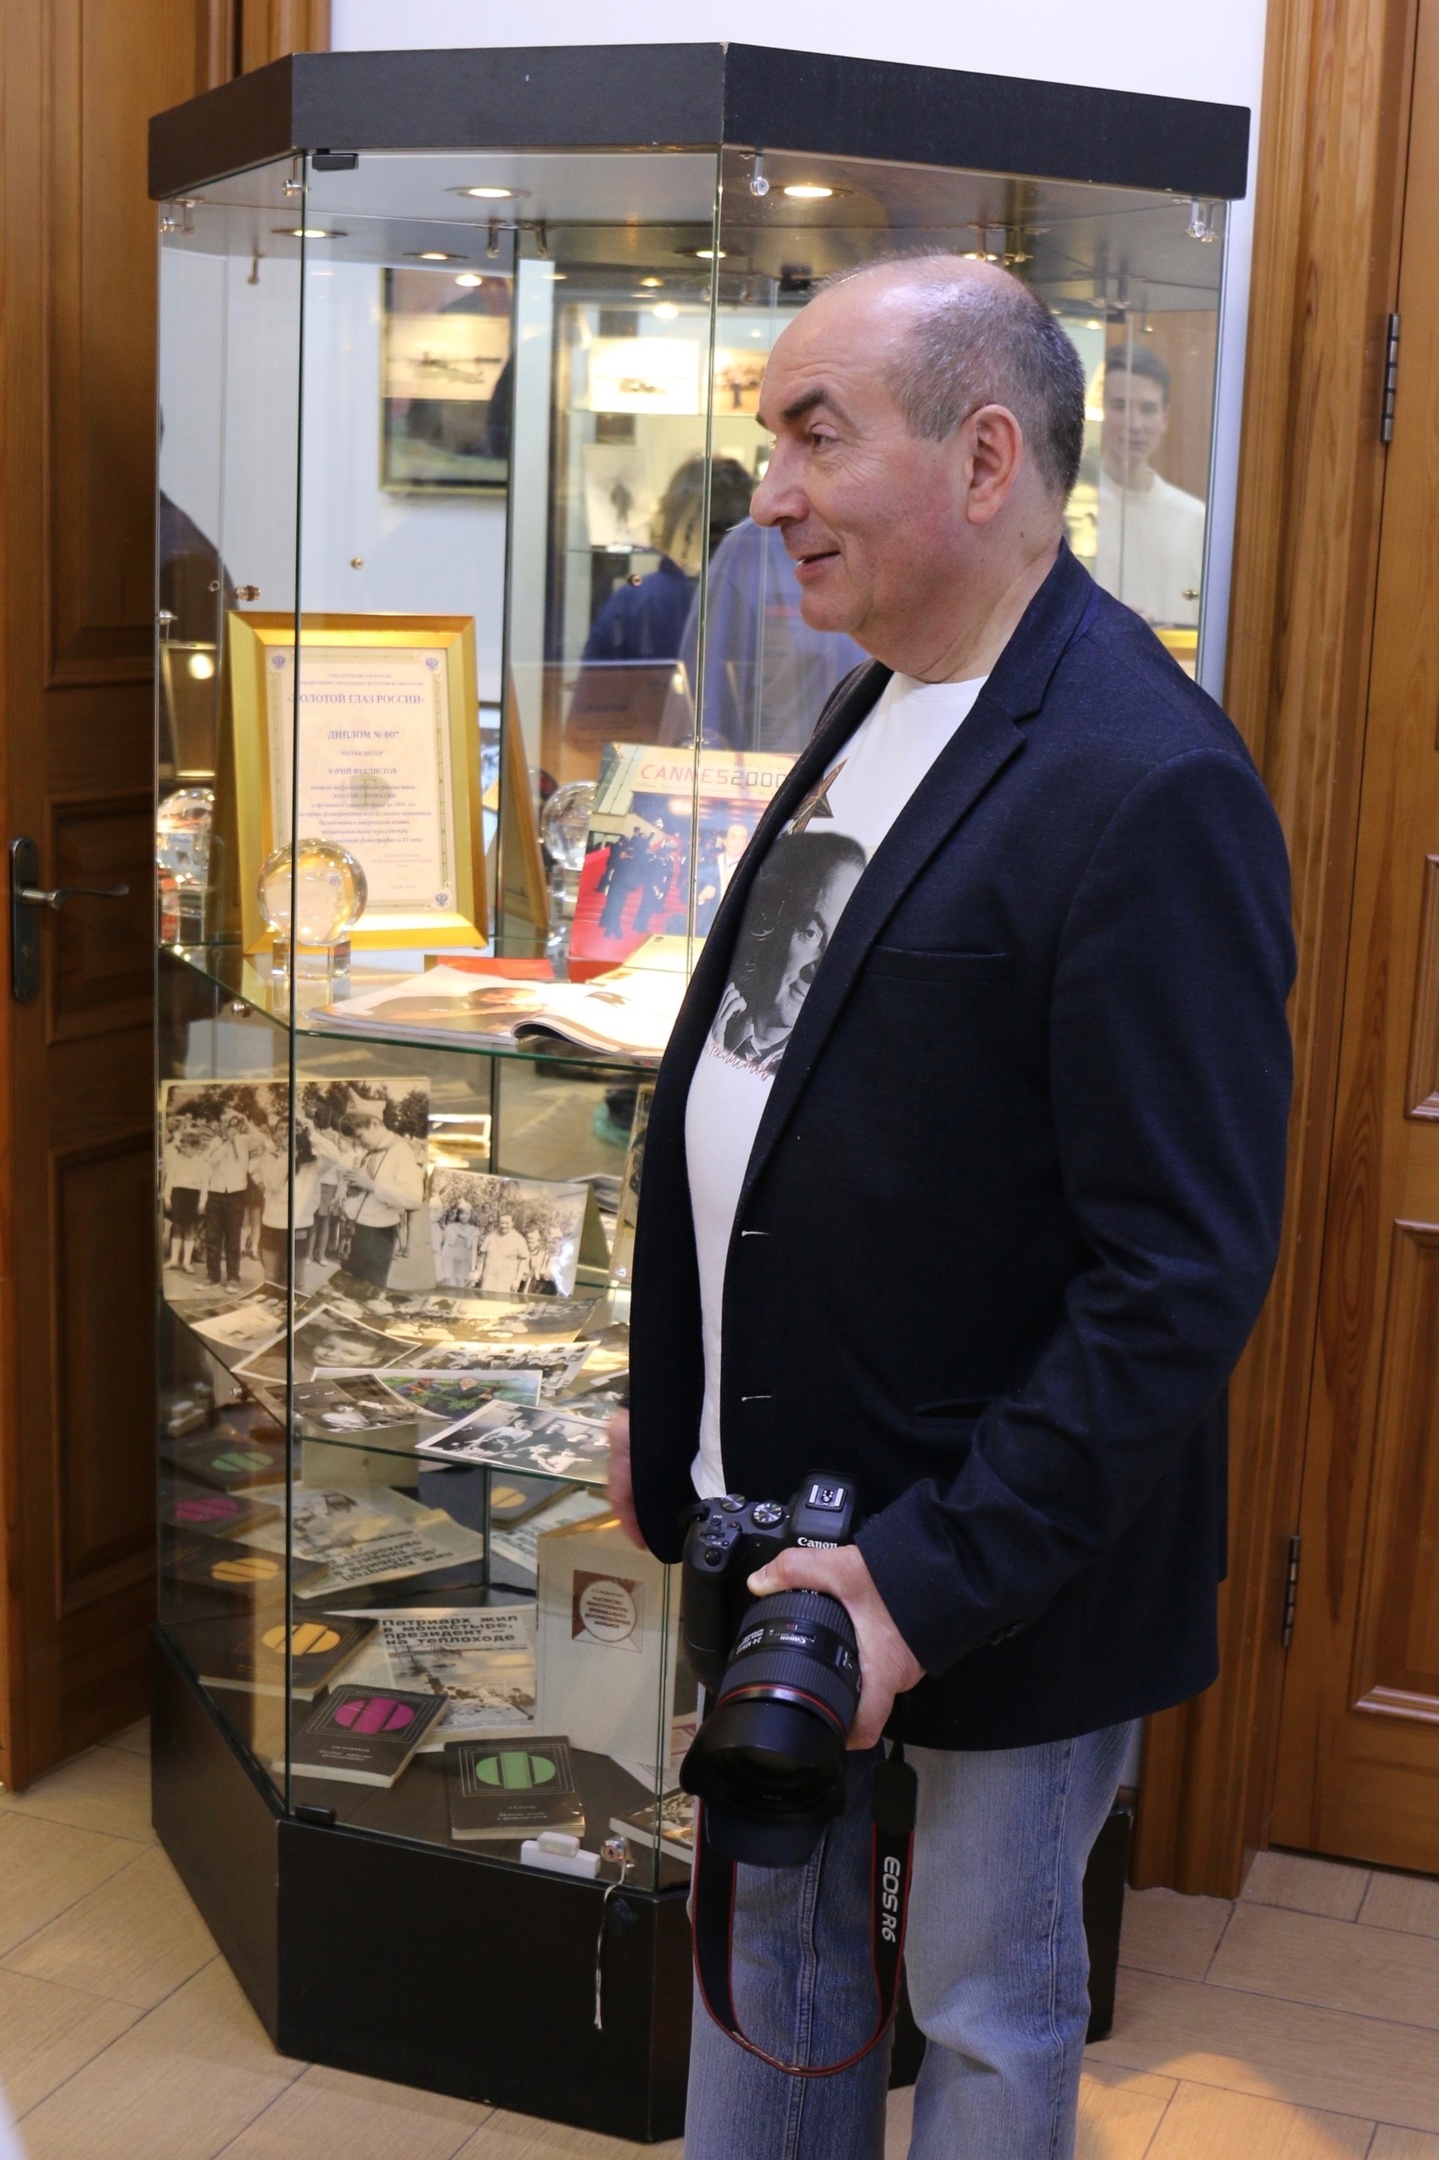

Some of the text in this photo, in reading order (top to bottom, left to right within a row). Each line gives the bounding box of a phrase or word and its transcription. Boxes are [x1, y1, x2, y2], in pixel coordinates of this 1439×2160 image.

[349, 694, 375, 704] ГЛАЗ
[328, 730, 371, 740] ДИПЛОМ
[797, 1536, 838, 1550] Canon
[382, 1615, 518, 1627] Патриарх жил
[402, 1621, 513, 1632] монастыре,
[384, 1629, 483, 1640] президент
[385, 1634, 515, 1646] на теплоходе
[882, 1856, 901, 1943] EOS R6
